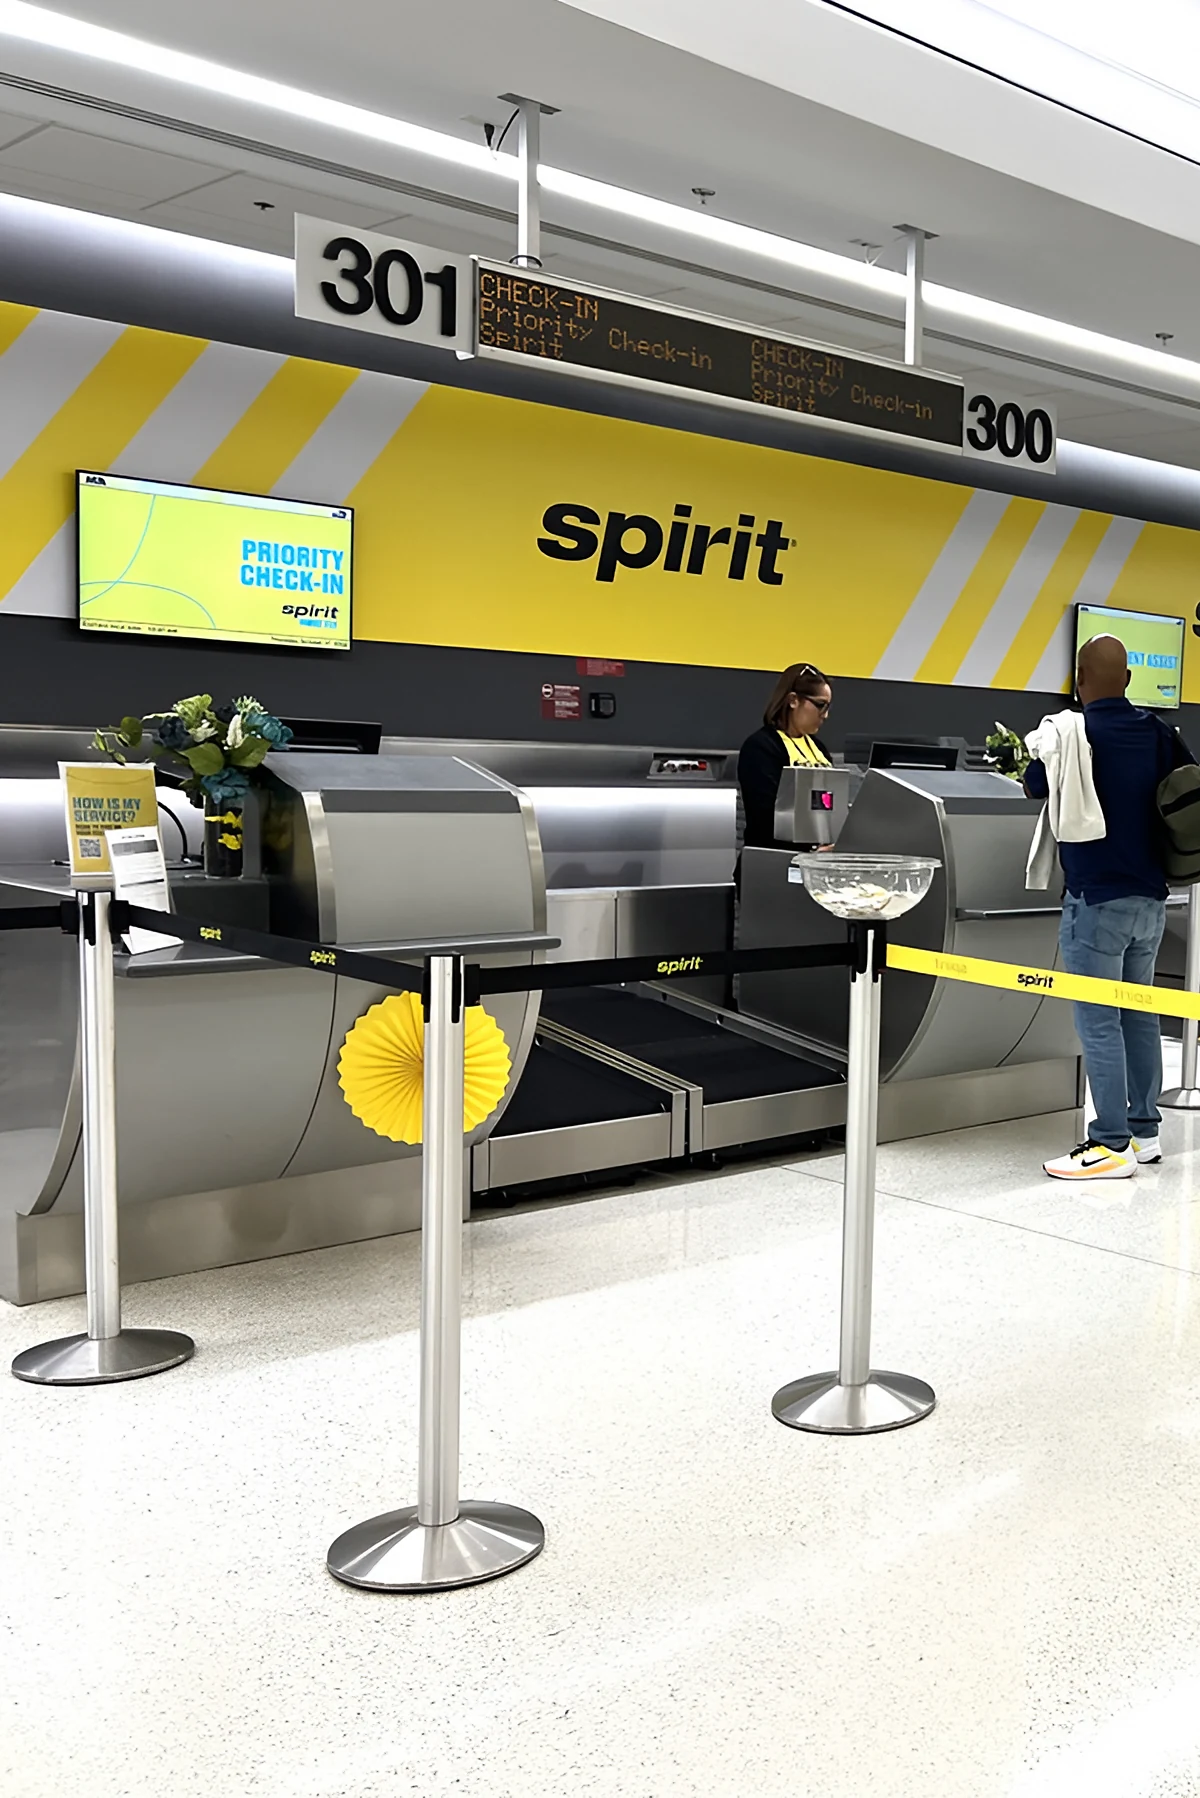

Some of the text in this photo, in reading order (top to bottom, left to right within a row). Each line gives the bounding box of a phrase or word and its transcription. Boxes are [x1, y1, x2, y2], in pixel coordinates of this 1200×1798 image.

[320, 236, 457, 337] 301
[480, 272, 599, 322] CHECK-IN
[480, 322, 564, 361] Spirit
[481, 299, 712, 371] Priority Check-in
[751, 339, 844, 379] CHECK-IN
[751, 361, 933, 420] Priority Check-in
[966, 394, 1053, 463] 300
[241, 539, 344, 571] PRIORITY
[536, 502, 791, 586] spirit
[240, 564, 344, 595] CHECK-IN
[281, 604, 339, 619] spirit
[73, 797, 141, 810] HOW IS MY
[75, 810, 136, 823] SERVICE?
[310, 949, 337, 967] spirit
[657, 956, 704, 976] spirit
[1017, 971, 1056, 989] spirit
